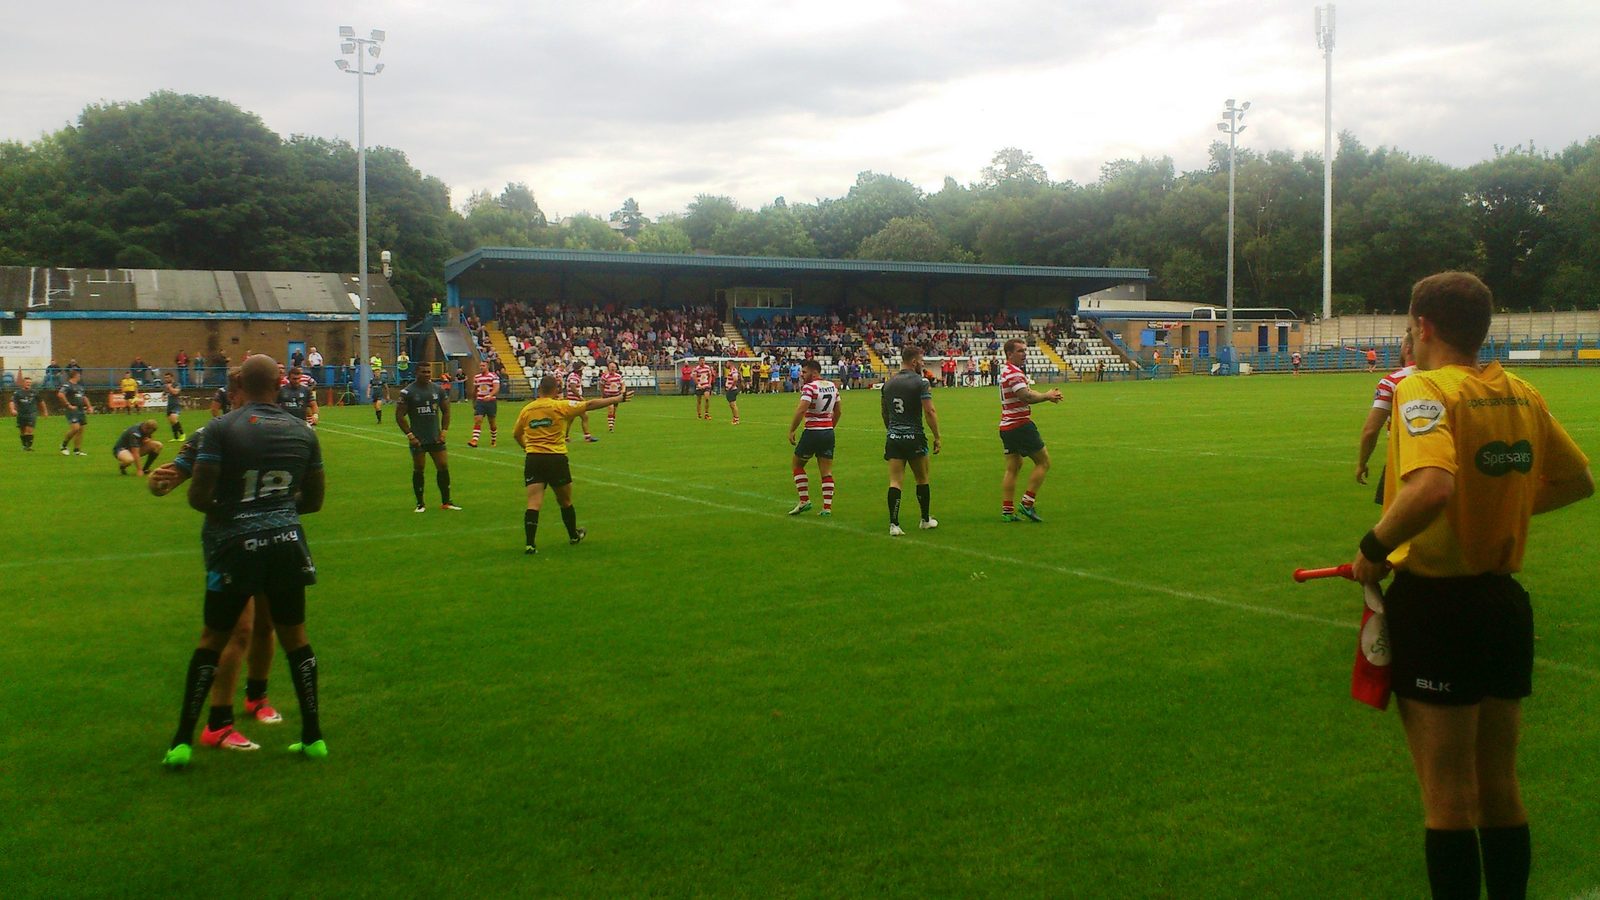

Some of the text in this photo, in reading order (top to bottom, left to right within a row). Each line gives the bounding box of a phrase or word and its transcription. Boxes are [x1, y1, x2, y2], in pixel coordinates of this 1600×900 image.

[821, 394, 833, 412] 7
[892, 398, 905, 414] 3
[1405, 403, 1439, 414] DACIA
[244, 529, 299, 552] Qurky
[1415, 678, 1452, 692] BLK
